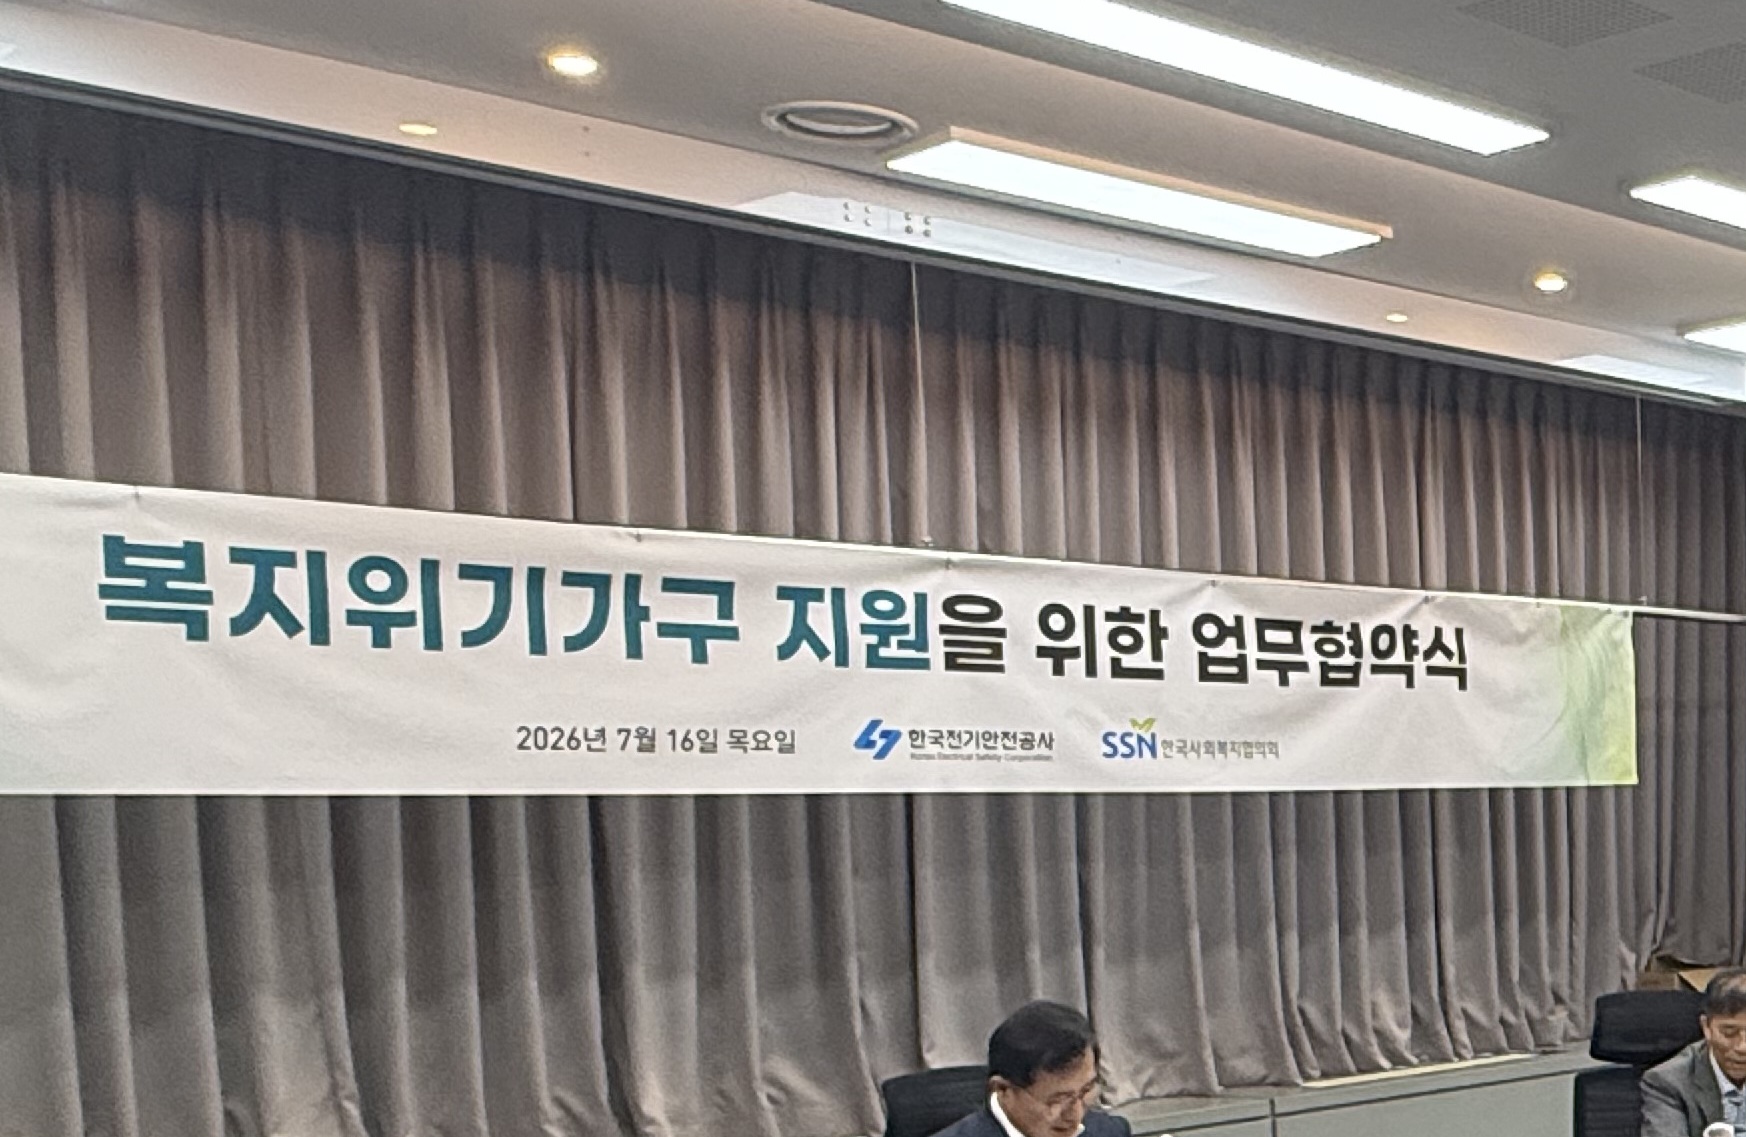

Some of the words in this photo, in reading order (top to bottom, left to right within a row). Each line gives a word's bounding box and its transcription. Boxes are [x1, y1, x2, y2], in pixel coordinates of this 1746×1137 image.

[98, 534, 740, 664] 복지위기가구
[776, 586, 1008, 674] 지원을
[1036, 602, 1169, 681] 위한
[1192, 611, 1468, 691] 업무협약식
[516, 725, 607, 753] 2026년
[616, 726, 657, 754] 7월
[667, 728, 718, 755] 16일
[726, 729, 796, 755] 목요일
[908, 729, 1055, 751] 한국전기안전공사
[1102, 731, 1158, 760] SSN
